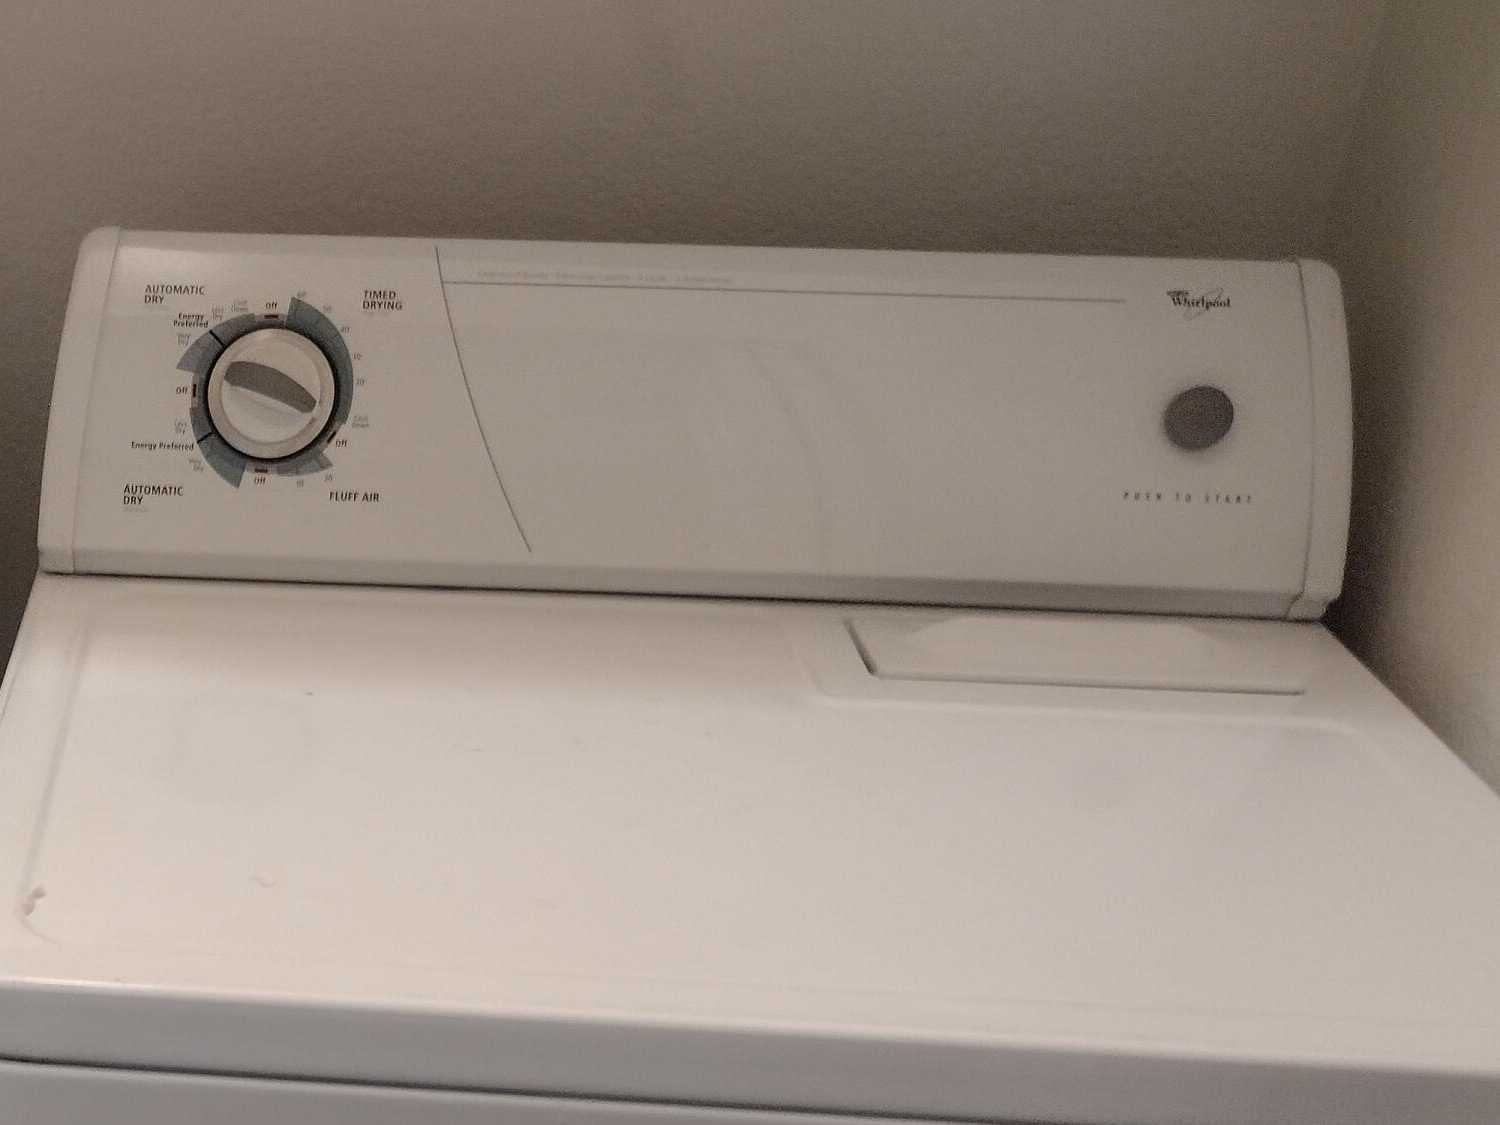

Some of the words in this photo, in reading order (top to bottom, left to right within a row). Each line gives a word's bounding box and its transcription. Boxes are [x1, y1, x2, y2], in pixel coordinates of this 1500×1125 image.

[145, 285, 205, 295] AUTOMATIC
[144, 295, 164, 304] DRY
[364, 291, 396, 300] TIMED
[1166, 289, 1231, 310] Whirlpool
[362, 301, 402, 310] DRYING
[179, 312, 204, 321] Energy
[174, 320, 209, 328] Preferred
[176, 387, 188, 395] Off
[131, 441, 156, 450] Energy
[159, 442, 194, 450] Preferred
[335, 439, 347, 447] Off
[254, 476, 266, 485] Off
[123, 484, 184, 496] AUTOMATIC
[123, 496, 143, 505] DRY
[329, 491, 358, 502] FLUFF
[361, 492, 379, 502] AIR
